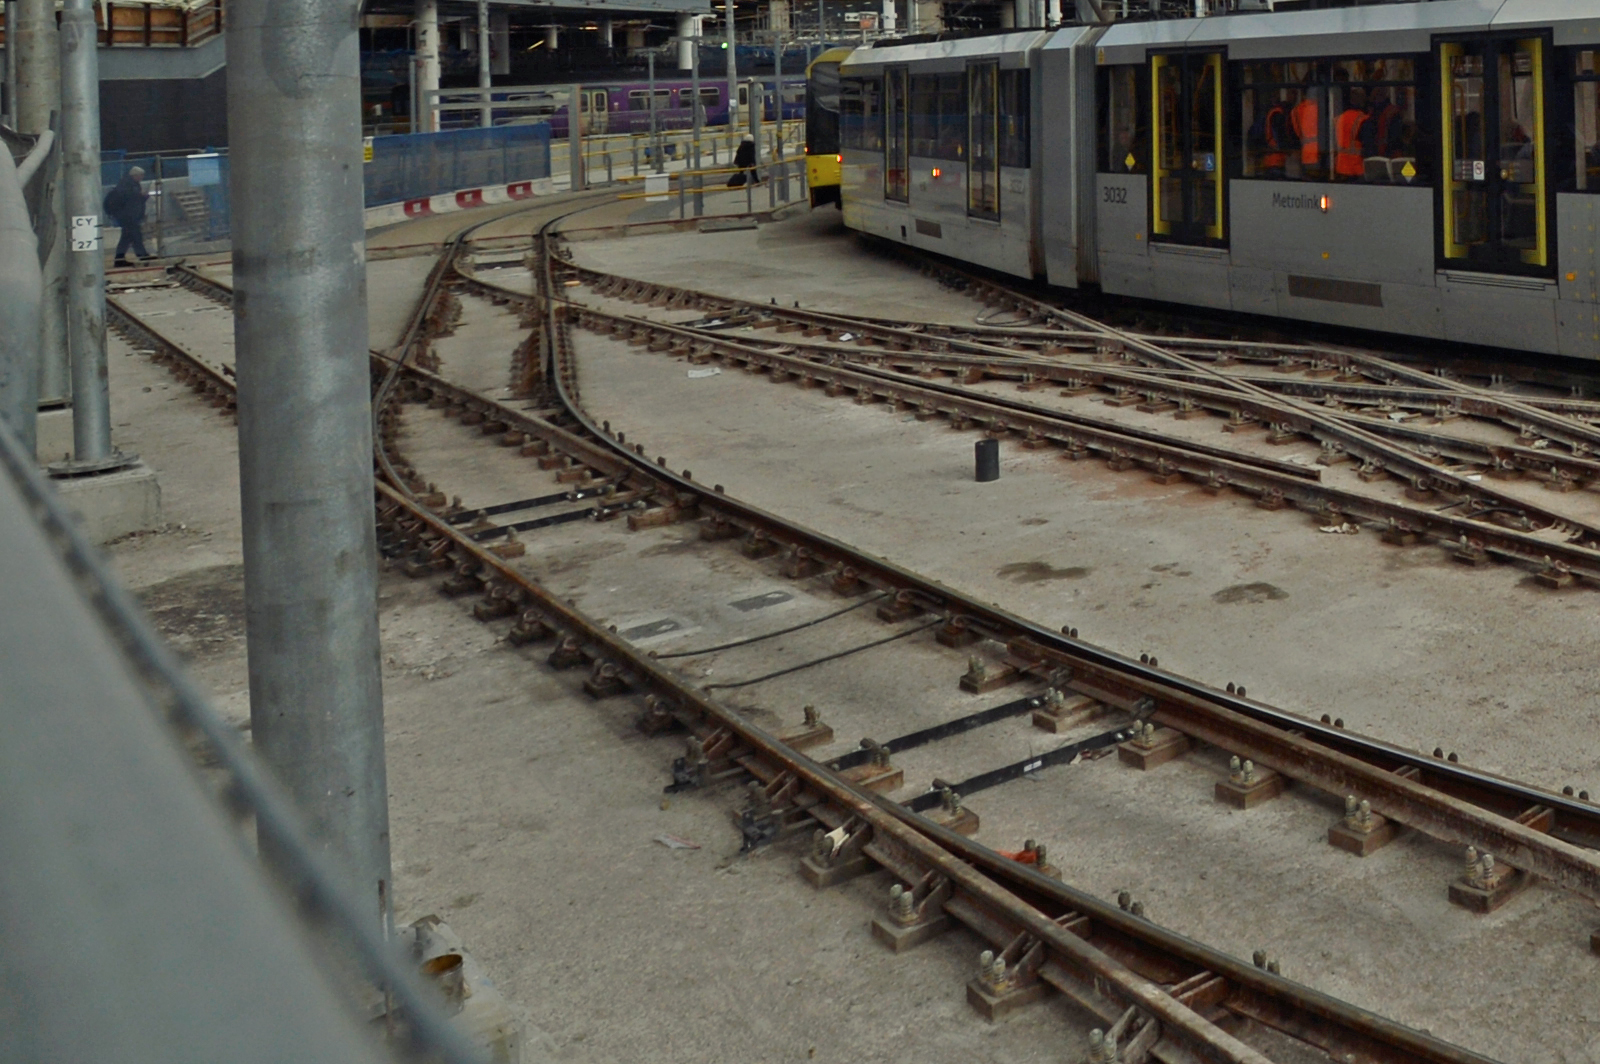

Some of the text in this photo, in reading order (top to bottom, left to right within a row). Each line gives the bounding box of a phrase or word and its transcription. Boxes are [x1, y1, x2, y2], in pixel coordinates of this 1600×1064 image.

[1103, 186, 1127, 204] 3032
[1272, 192, 1320, 209] Metrolink
[76, 218, 93, 227] CY
[77, 240, 92, 249] 27
